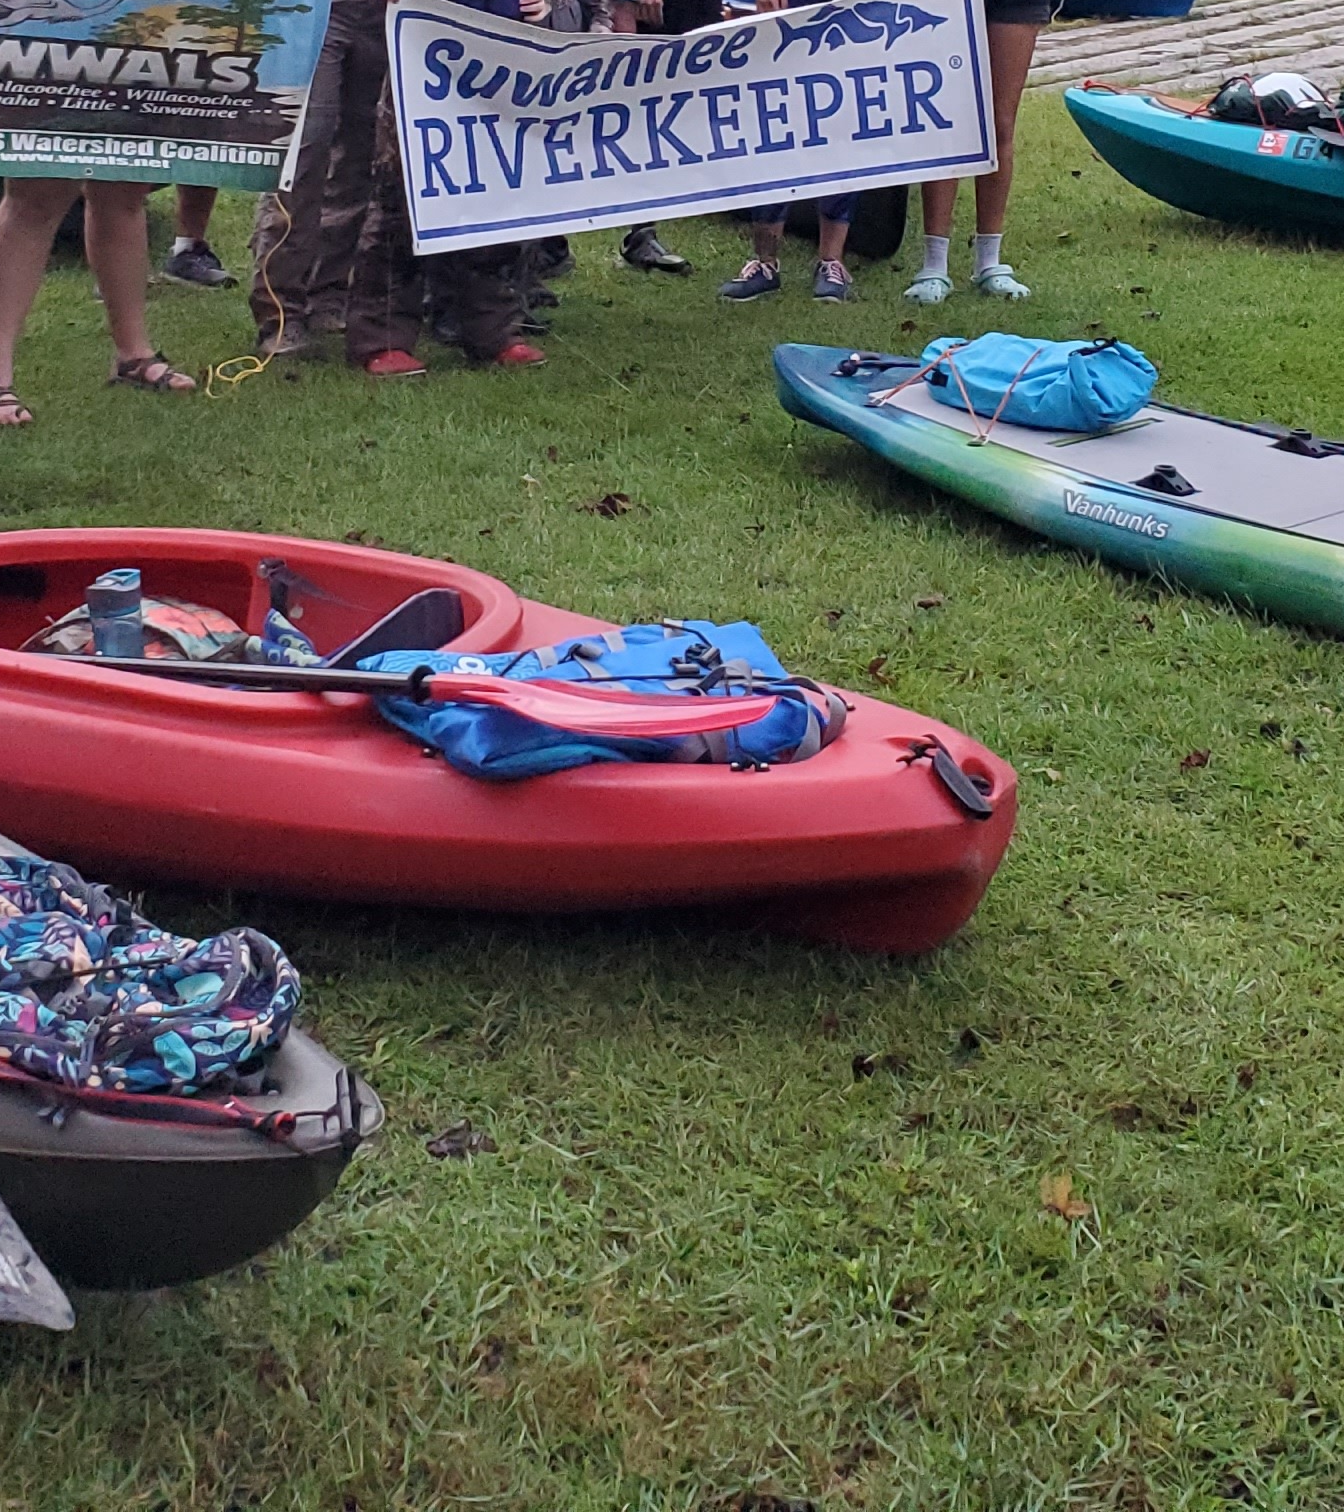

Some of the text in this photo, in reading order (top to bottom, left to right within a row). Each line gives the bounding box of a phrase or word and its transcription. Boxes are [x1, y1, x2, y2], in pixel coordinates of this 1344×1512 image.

[424, 25, 758, 107] Suwannee
[60, 97, 117, 112] Little
[139, 102, 239, 120] Suwannee
[127, 88, 254, 108] Willacoochee
[0, 152, 171, 170] www.wwals.net
[11, 133, 154, 157] Watershed
[159, 141, 280, 167] Coalition
[1065, 489, 1170, 538] Vanhunks
